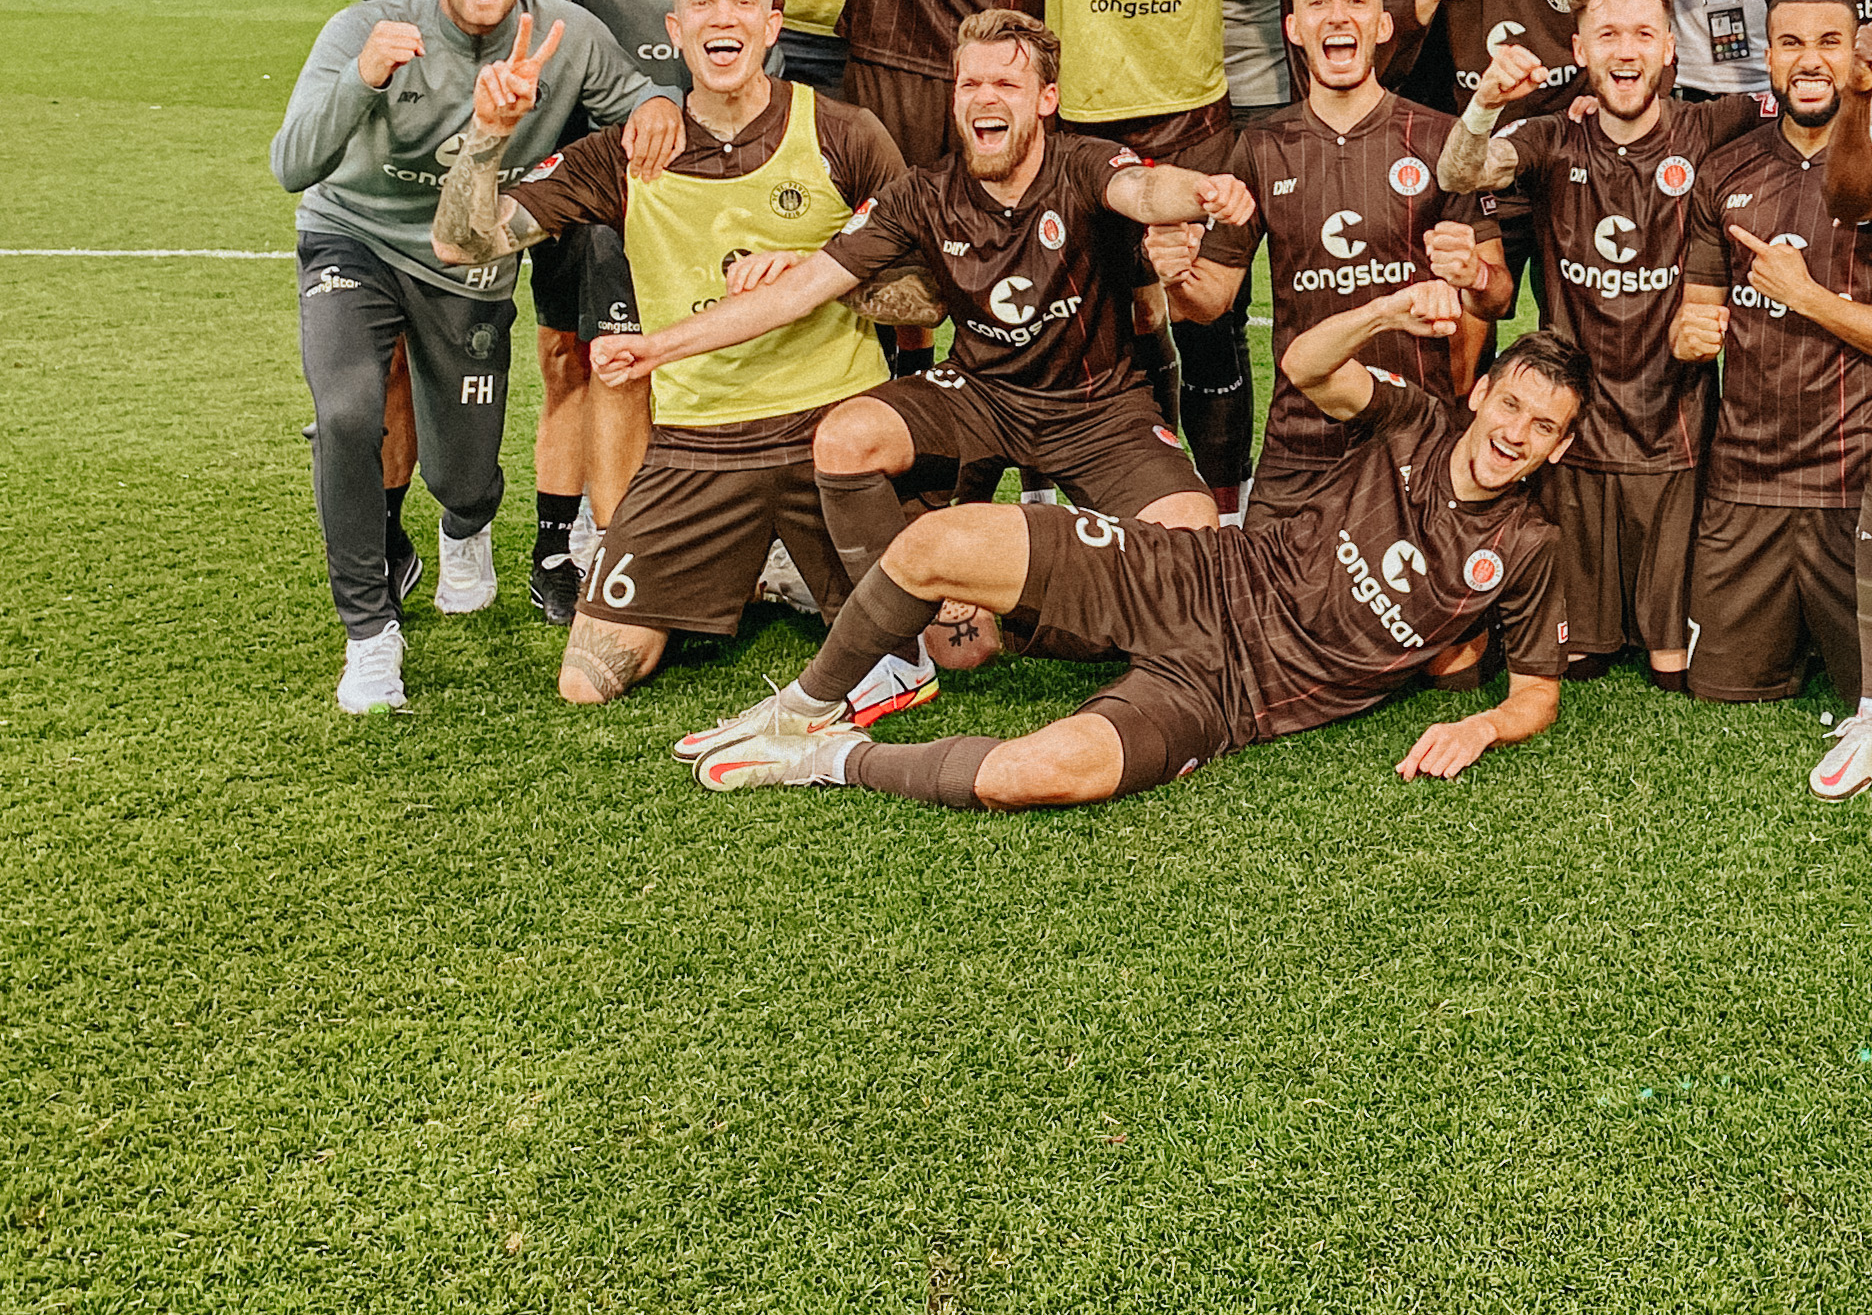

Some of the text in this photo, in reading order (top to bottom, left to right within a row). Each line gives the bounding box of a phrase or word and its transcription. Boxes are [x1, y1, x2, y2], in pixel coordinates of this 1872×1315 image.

[465, 265, 499, 290] FH
[1293, 259, 1416, 296] congstar
[1559, 257, 1681, 299] congstar
[598, 319, 641, 334] congsta
[461, 374, 495, 405] FH
[586, 546, 636, 608] 16
